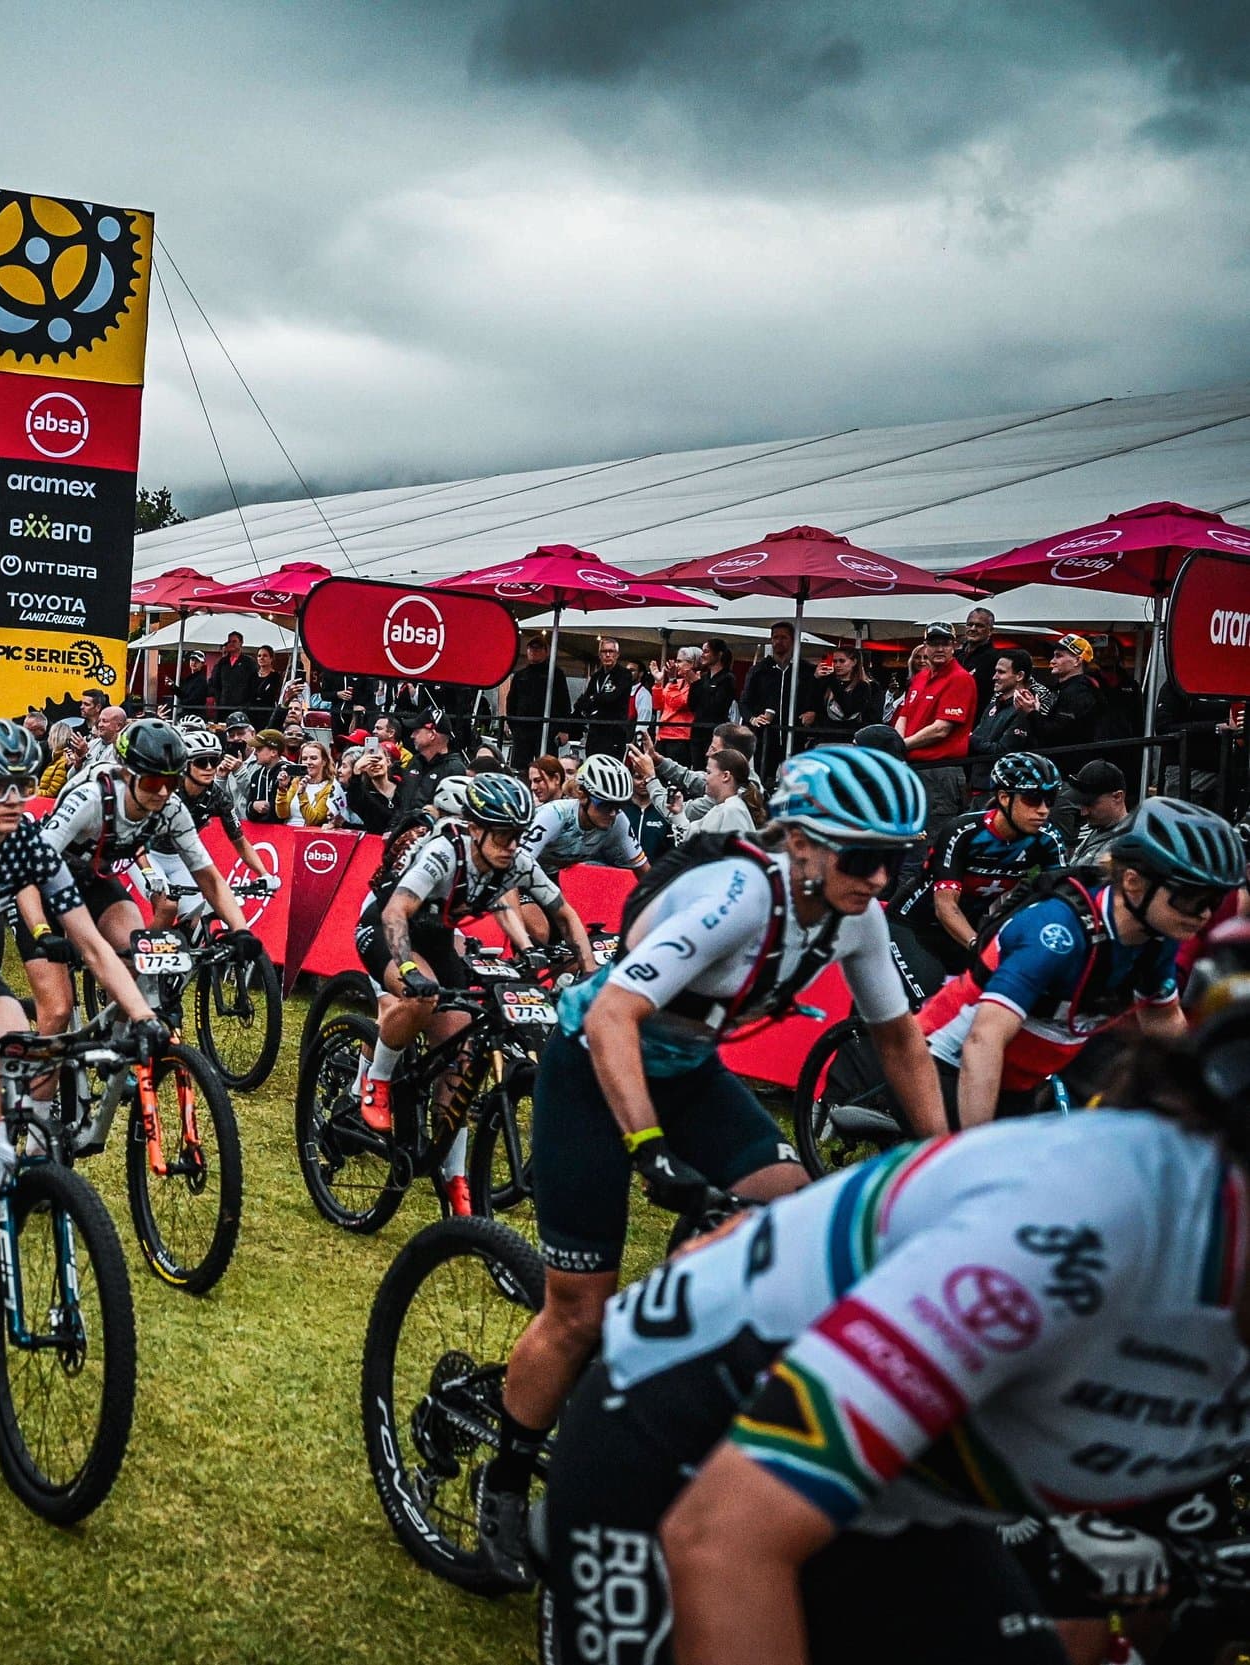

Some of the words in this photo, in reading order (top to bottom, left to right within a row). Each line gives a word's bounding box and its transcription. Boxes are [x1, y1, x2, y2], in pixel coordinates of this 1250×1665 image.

[33, 411, 82, 435] absa
[7, 473, 96, 498] aramex
[9, 513, 92, 543] exxaro
[6, 591, 86, 614] TOYOTA
[19, 609, 46, 622] LAND
[45, 611, 86, 627] CRUISER
[389, 619, 439, 646] absa
[24, 647, 90, 668] SERIES
[24, 664, 60, 674] GLOBAL
[62, 667, 82, 676] MTB
[307, 848, 334, 862] absa
[900, 875, 934, 916] BULL
[145, 956, 181, 968] 77-2
[890, 941, 926, 998] BULLS
[515, 1006, 548, 1018] 77-1
